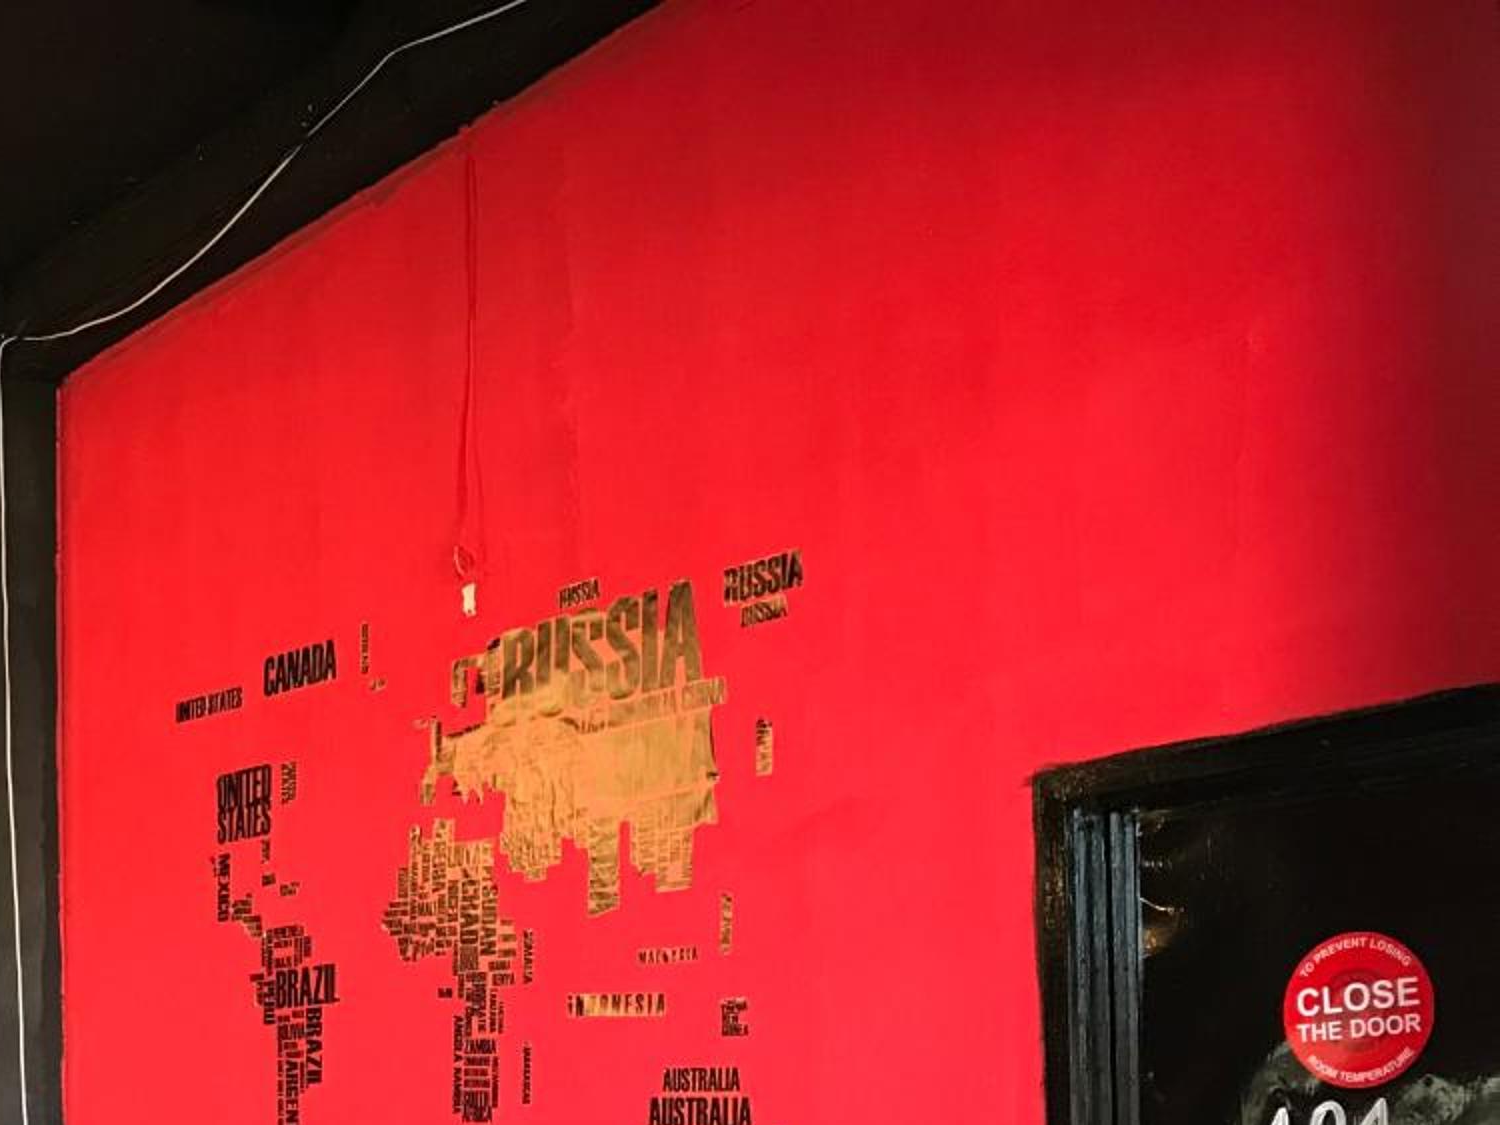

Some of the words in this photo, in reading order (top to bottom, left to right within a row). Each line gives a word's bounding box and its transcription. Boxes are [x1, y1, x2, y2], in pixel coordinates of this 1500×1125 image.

[724, 549, 803, 602] RUSSIA
[501, 580, 701, 701] RUSSIA
[264, 639, 336, 697] CANADA
[217, 764, 271, 808] UNITED
[217, 800, 271, 844] STATES
[461, 879, 479, 944] CHAD
[481, 884, 498, 956] SUDAN
[1299, 962, 1315, 978] TO
[1313, 936, 1368, 965] PREVENT
[1369, 937, 1413, 967] LOSING
[276, 963, 340, 1009] BRAZIL
[1296, 975, 1421, 1017] CLOSE
[306, 1007, 322, 1087] BRAZIL
[1296, 1018, 1343, 1043] THE
[1349, 1012, 1422, 1039] DOOR
[663, 1068, 740, 1092] AUSTRALIA
[1308, 1053, 1339, 1080] ROOM
[1337, 1046, 1416, 1083] TEMPERATURE
